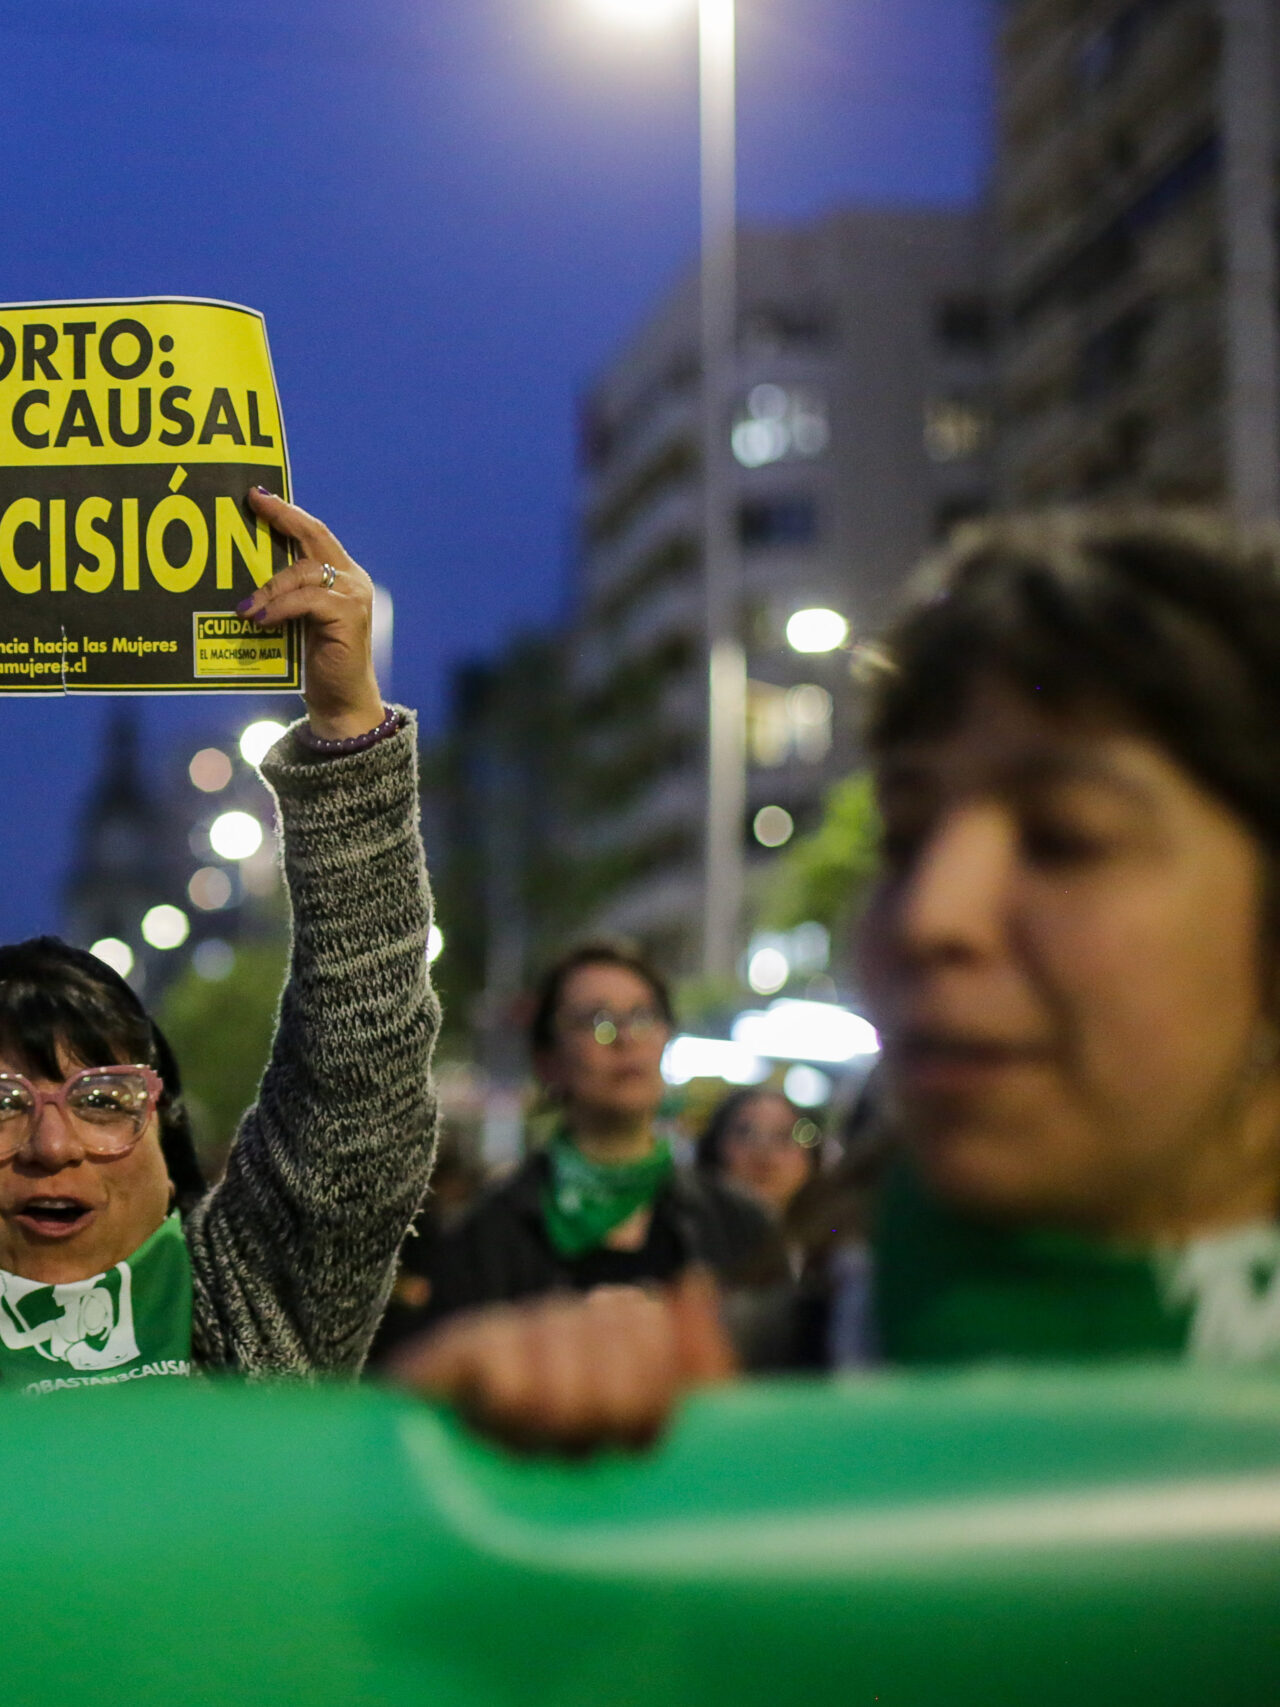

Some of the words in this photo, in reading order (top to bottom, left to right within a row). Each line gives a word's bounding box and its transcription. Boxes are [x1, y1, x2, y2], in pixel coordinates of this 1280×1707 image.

[12, 385, 274, 449] CAUSAL
[34, 636, 78, 653] hacia
[83, 636, 107, 653] las
[112, 636, 178, 657] Mujeres
[200, 649, 208, 660] EL
[211, 648, 257, 660] MACHISMO
[259, 648, 282, 660] MATA
